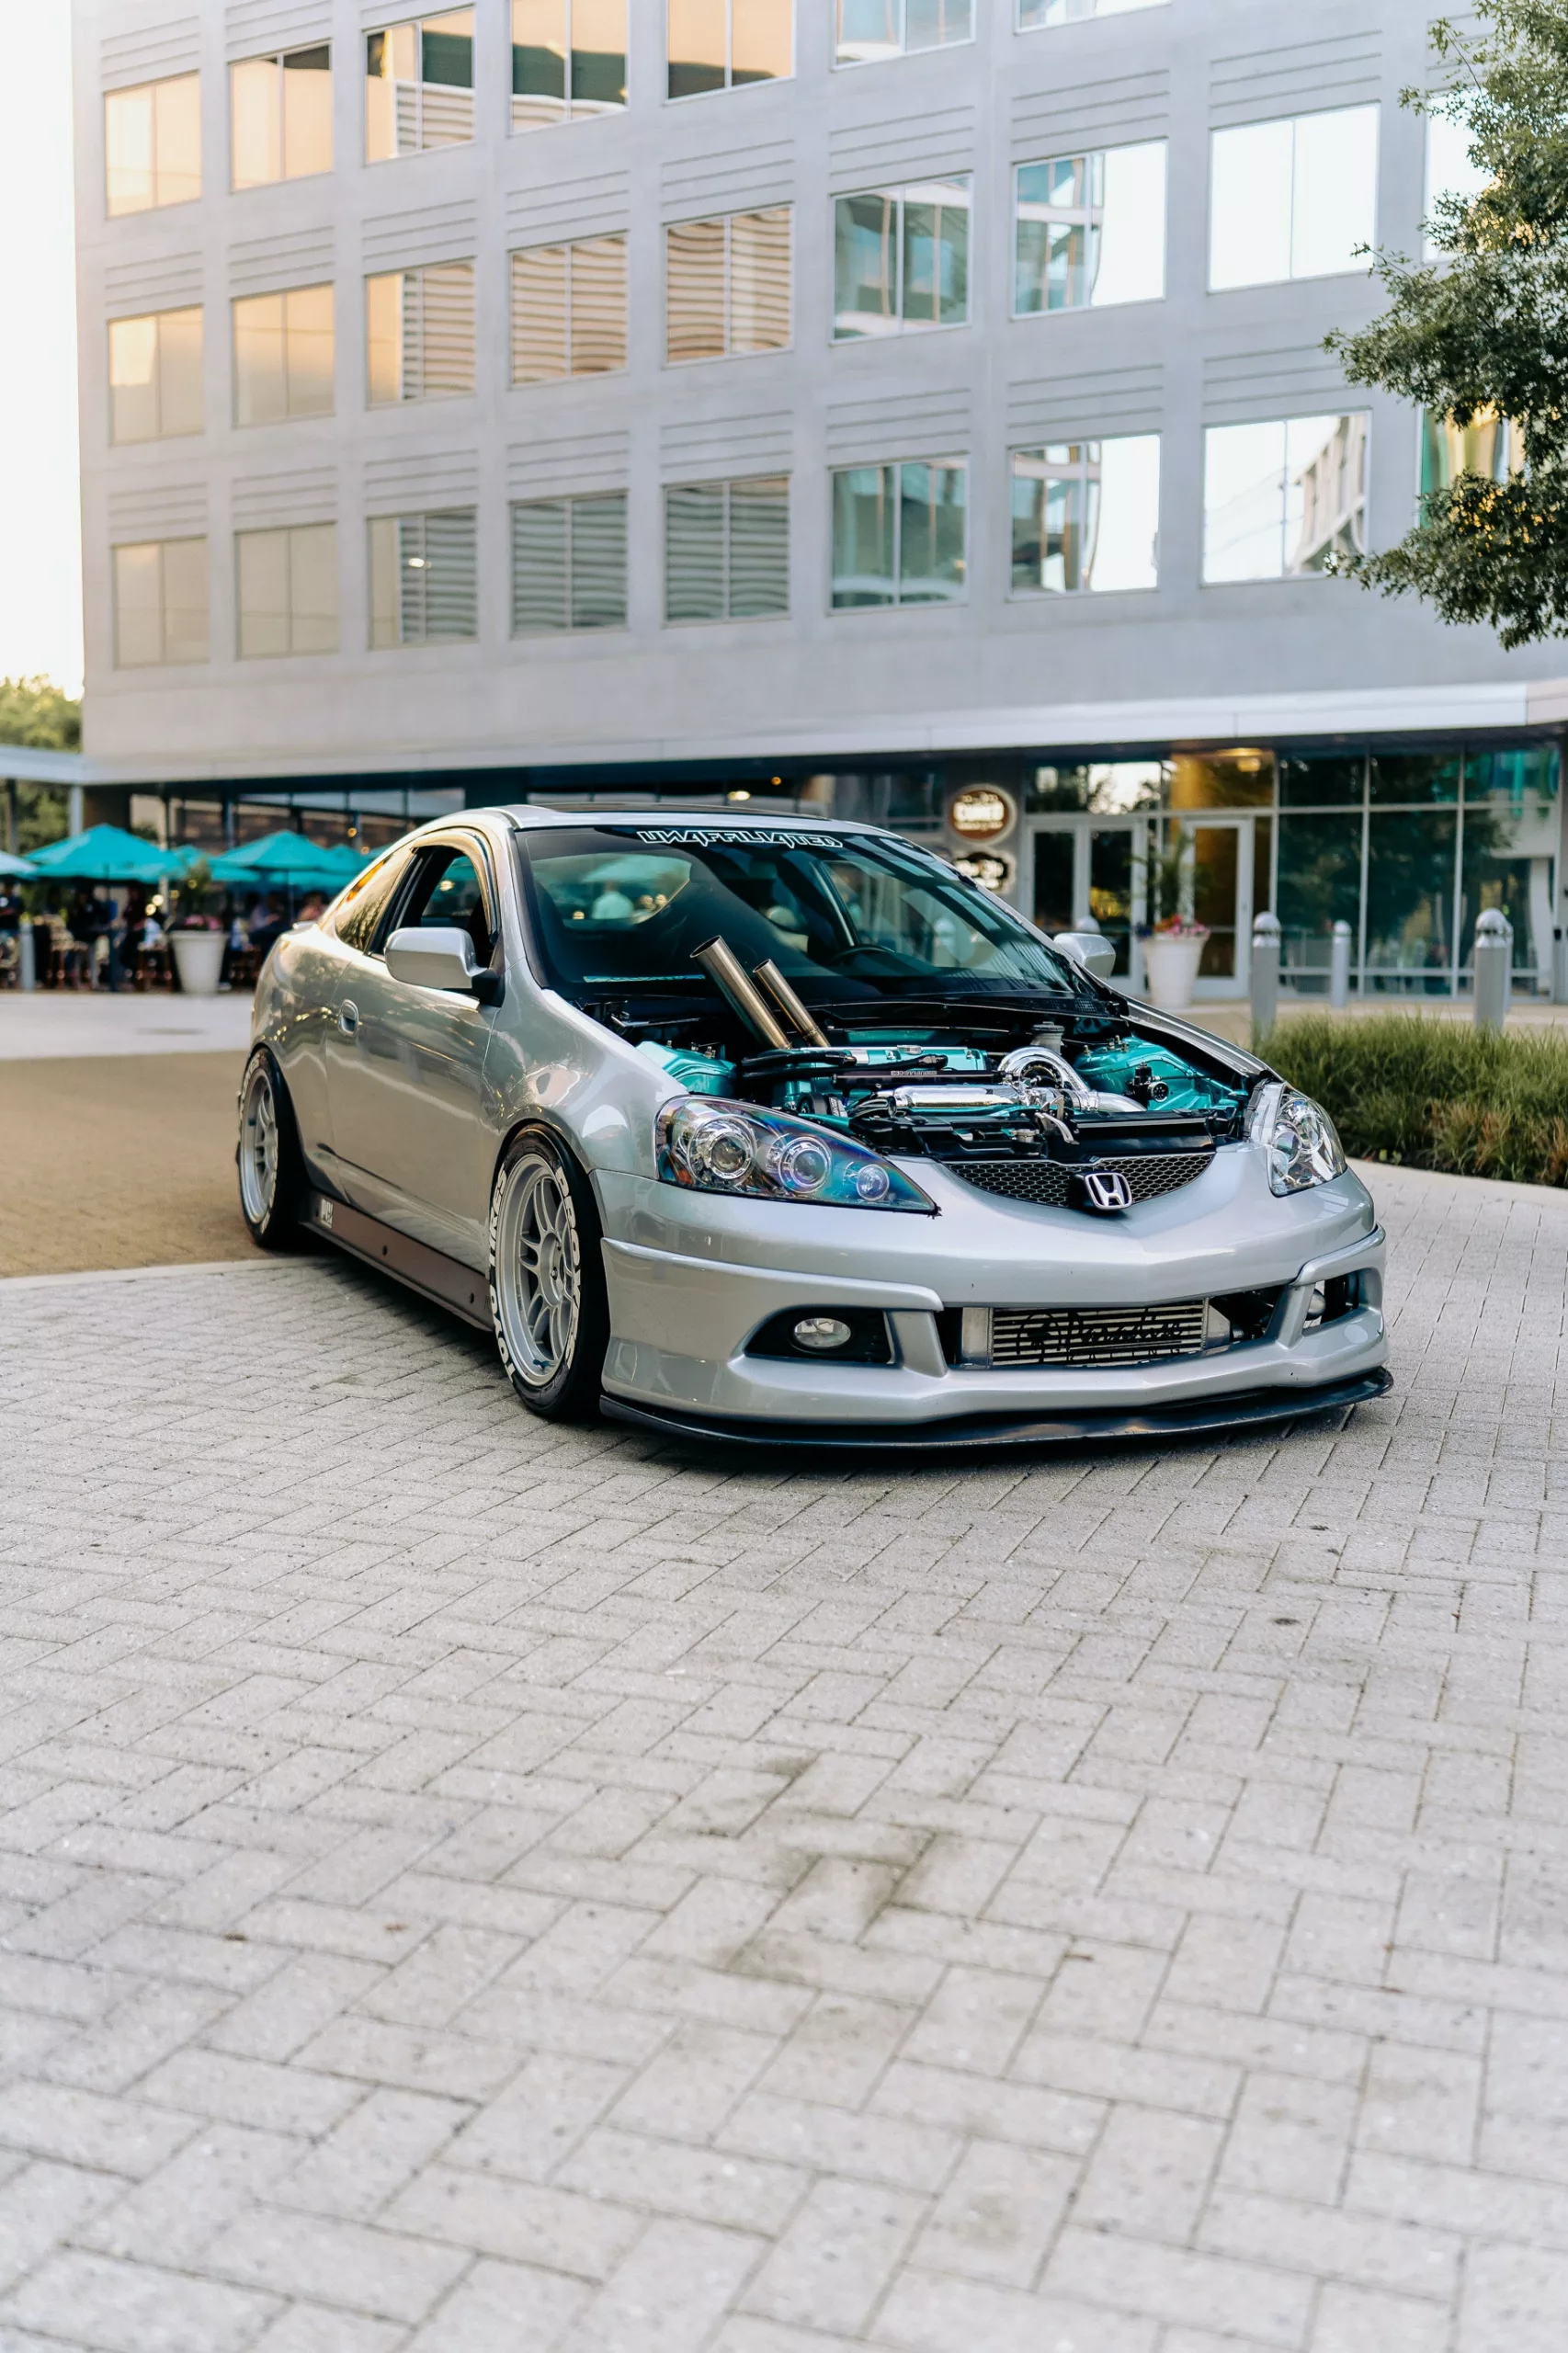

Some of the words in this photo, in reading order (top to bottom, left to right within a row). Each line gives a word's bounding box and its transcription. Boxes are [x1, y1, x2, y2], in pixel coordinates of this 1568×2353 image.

[637, 830, 844, 848] UNAFFILIATED
[489, 1162, 507, 1267] TIRES
[489, 1284, 517, 1383] TOYO
